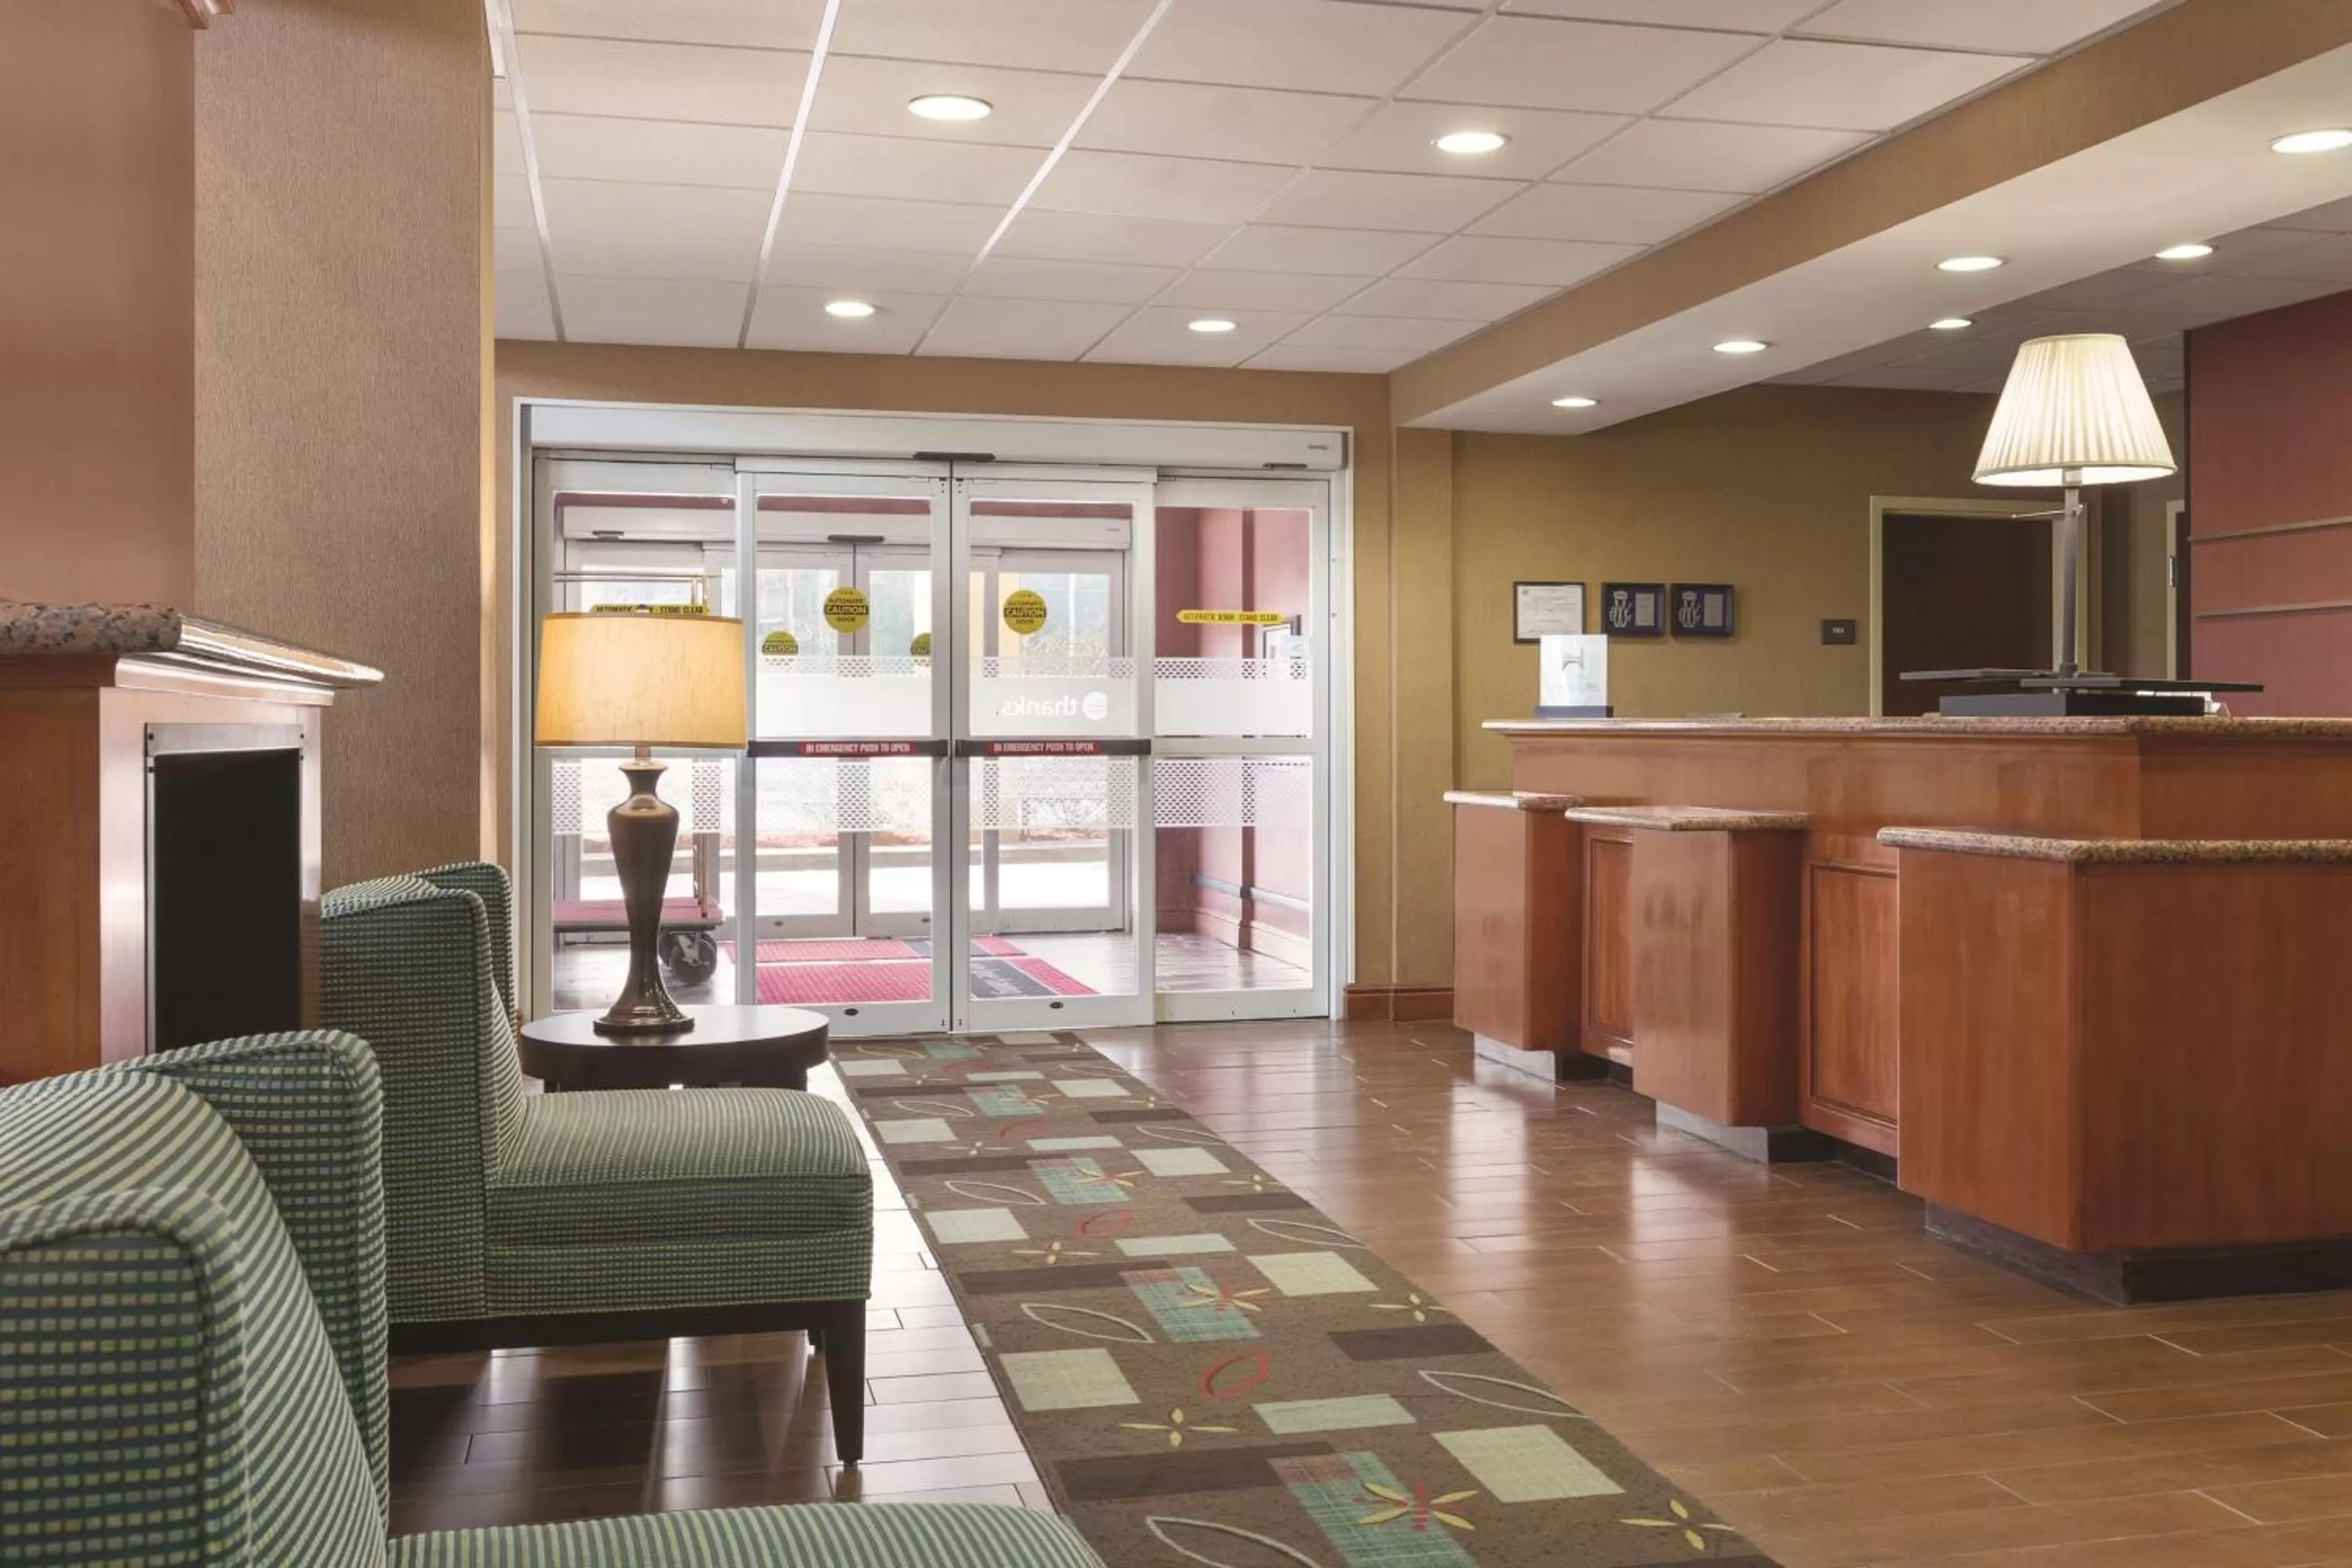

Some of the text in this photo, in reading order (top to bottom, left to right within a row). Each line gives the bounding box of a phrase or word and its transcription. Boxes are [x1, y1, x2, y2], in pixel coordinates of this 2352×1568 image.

[826, 605, 866, 614] CAUTION
[1005, 608, 1044, 617] CAUTION
[815, 743, 858, 753] EMERGENCY
[1003, 742, 1044, 752] EMERGENCY
